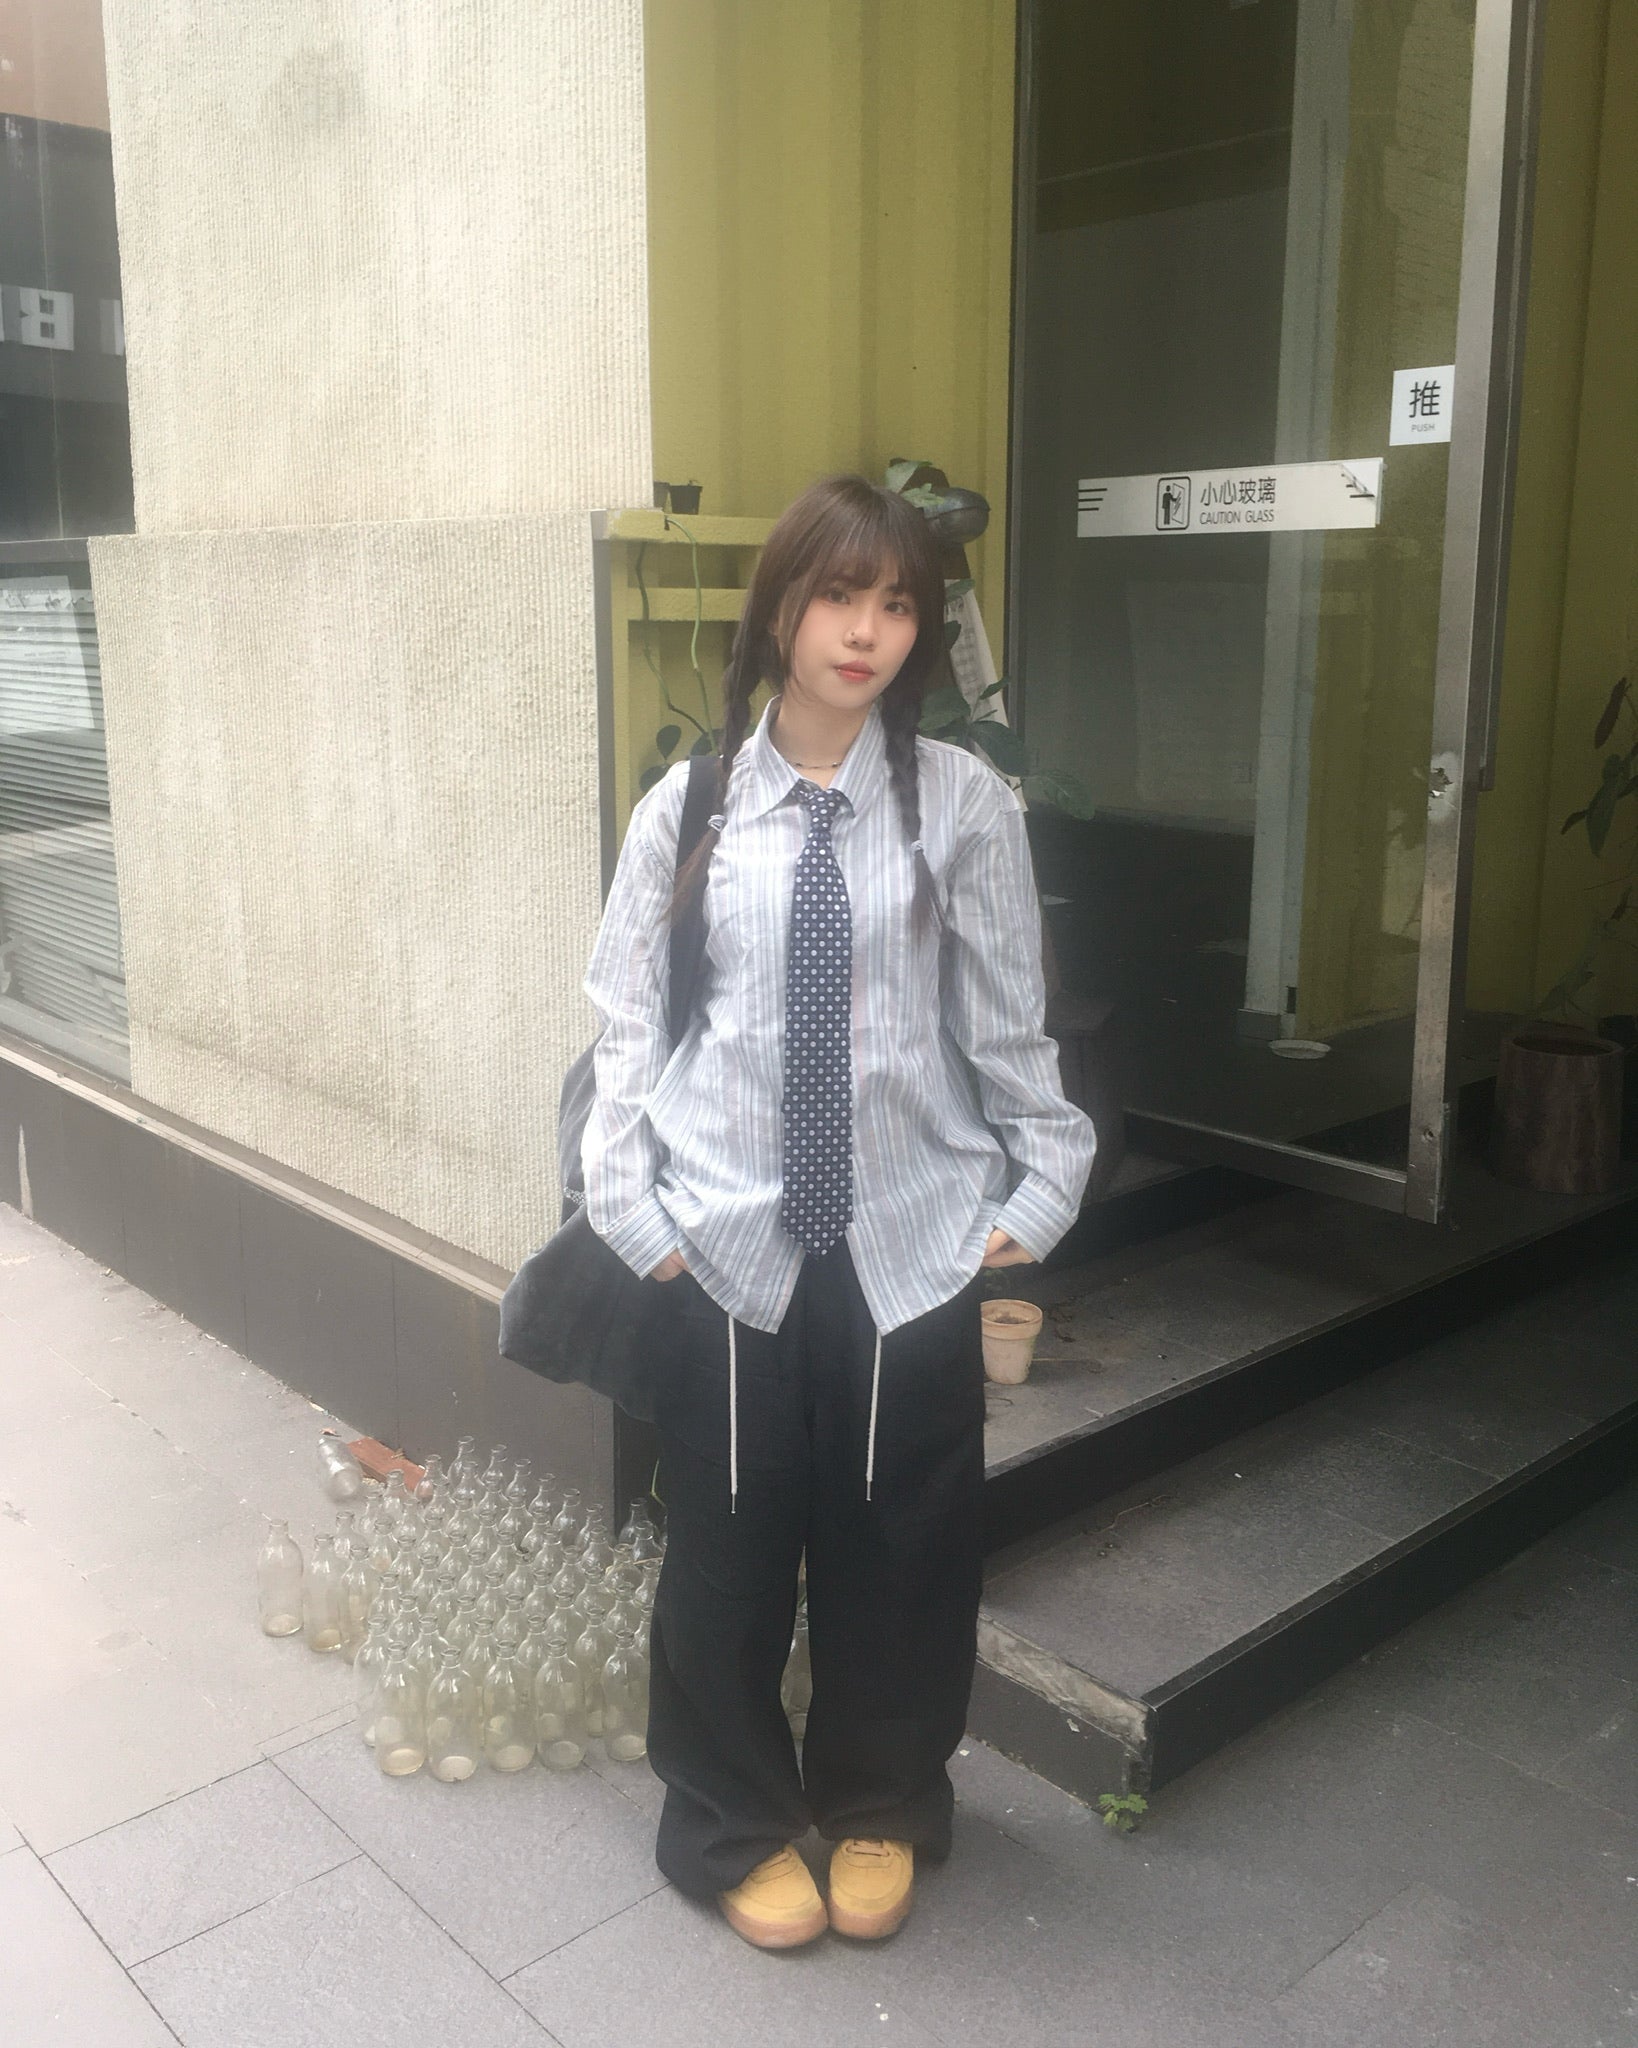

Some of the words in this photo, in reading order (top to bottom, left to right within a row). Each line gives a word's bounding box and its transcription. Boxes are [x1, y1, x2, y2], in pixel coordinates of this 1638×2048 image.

[1408, 380, 1441, 418] 推
[1411, 423, 1436, 432] PUSH
[1200, 476, 1277, 506] 小心玻璃
[1199, 511, 1241, 525] CAUTION
[1245, 509, 1275, 523] GLASS
